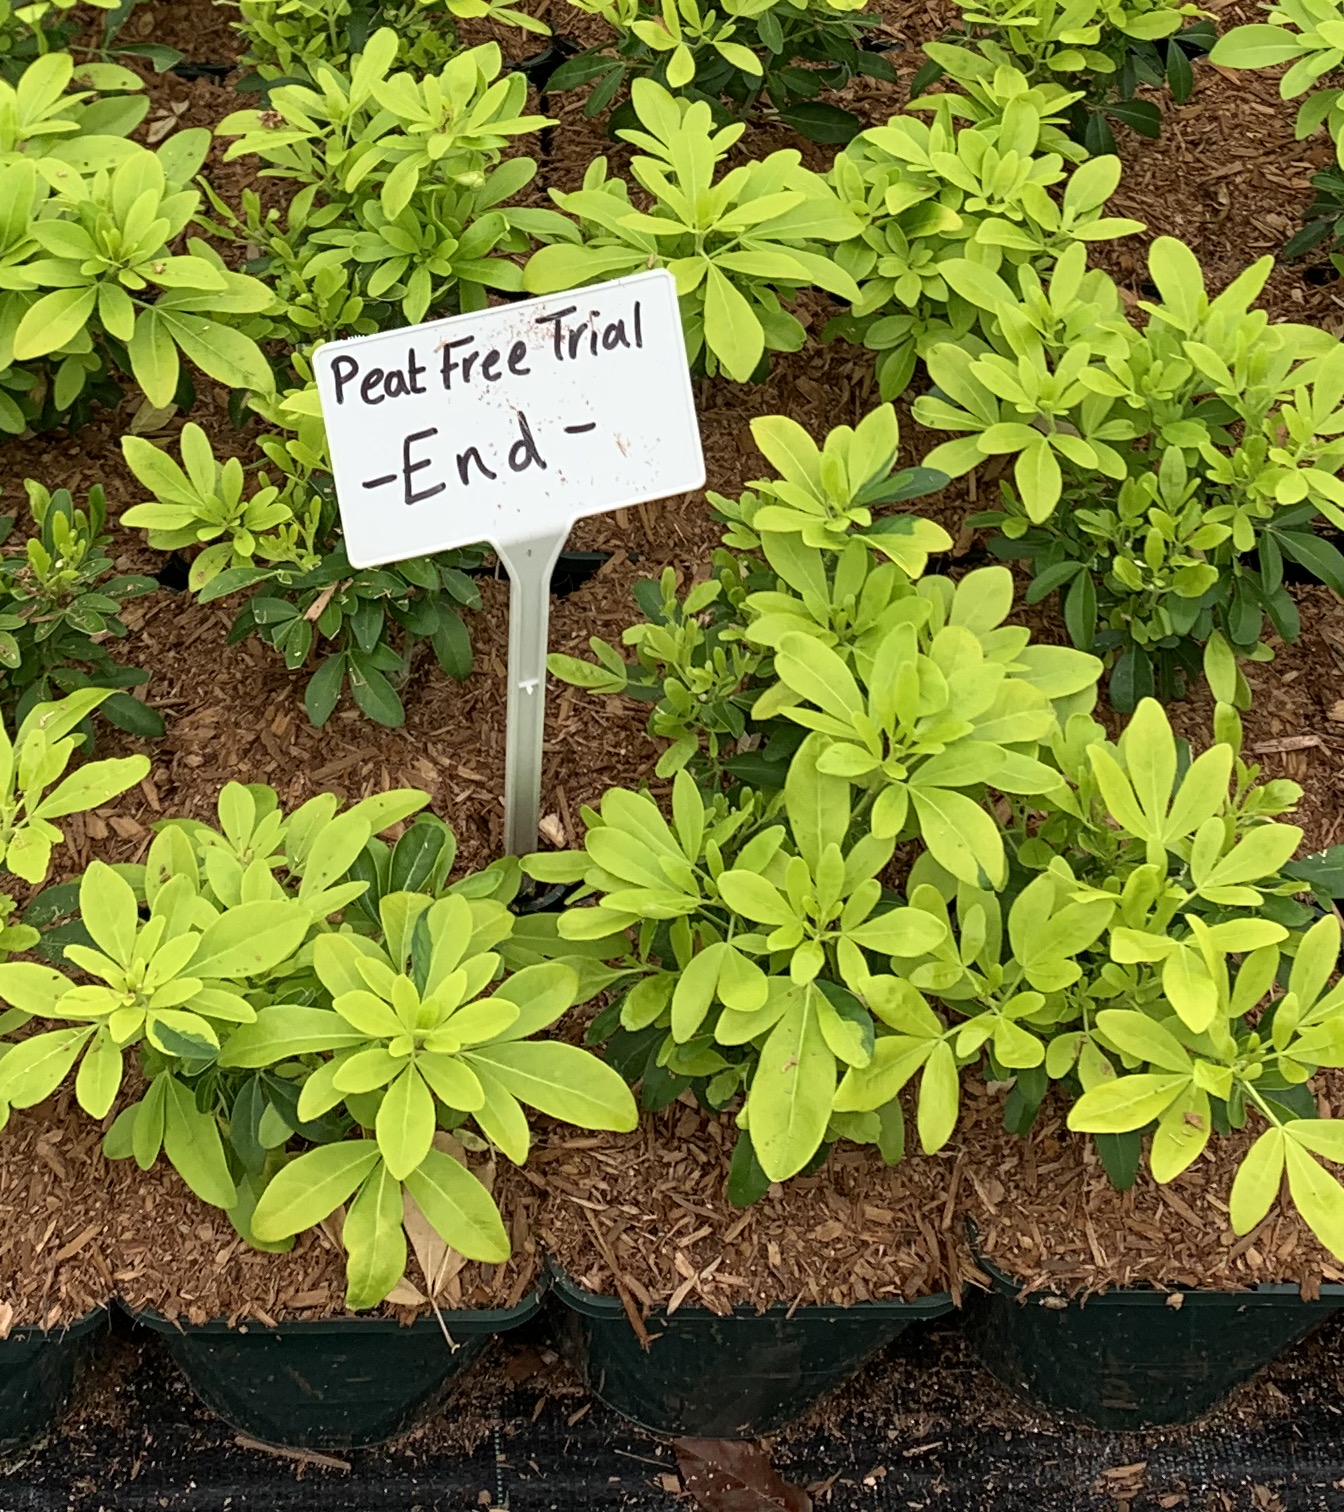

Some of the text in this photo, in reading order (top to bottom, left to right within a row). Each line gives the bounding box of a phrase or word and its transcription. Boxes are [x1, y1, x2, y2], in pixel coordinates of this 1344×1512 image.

[331, 300, 644, 405] Peat Free Trial
